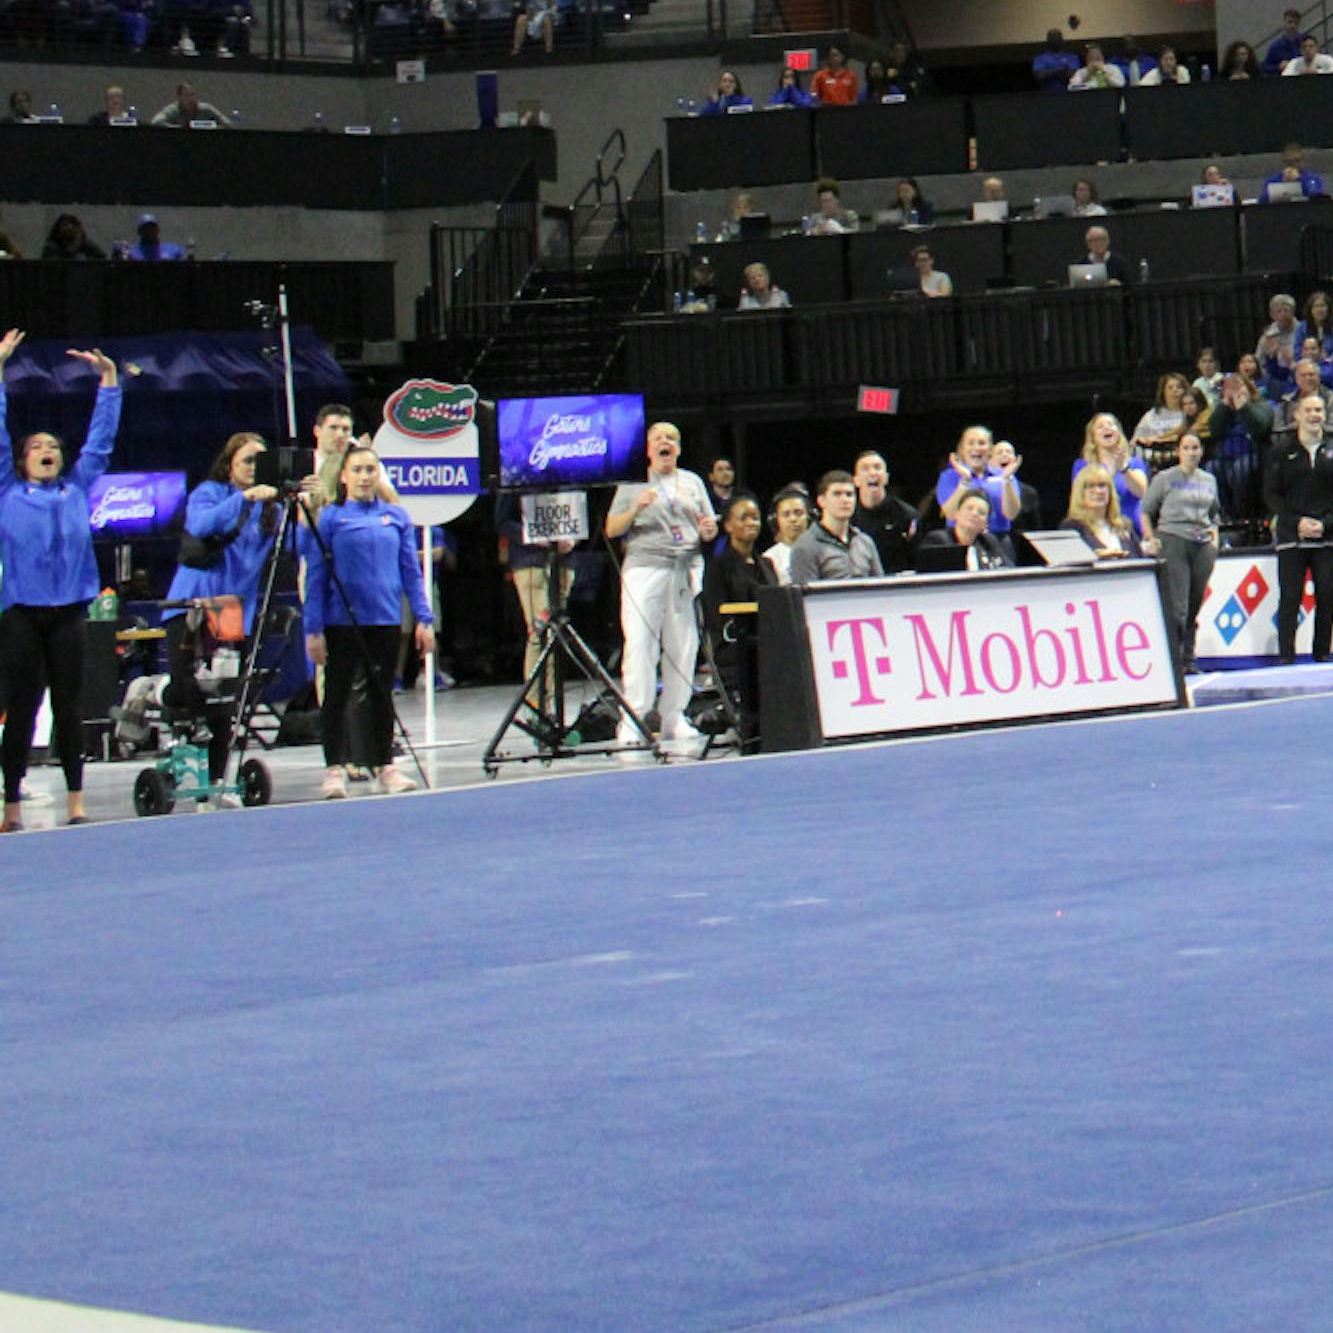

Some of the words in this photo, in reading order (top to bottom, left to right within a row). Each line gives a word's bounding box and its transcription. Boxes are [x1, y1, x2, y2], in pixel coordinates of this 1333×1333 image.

[386, 464, 469, 487] FLORIDA
[535, 505, 571, 523] FLOOR
[529, 518, 579, 539] EXERCISE
[902, 599, 1153, 701] Mobile
